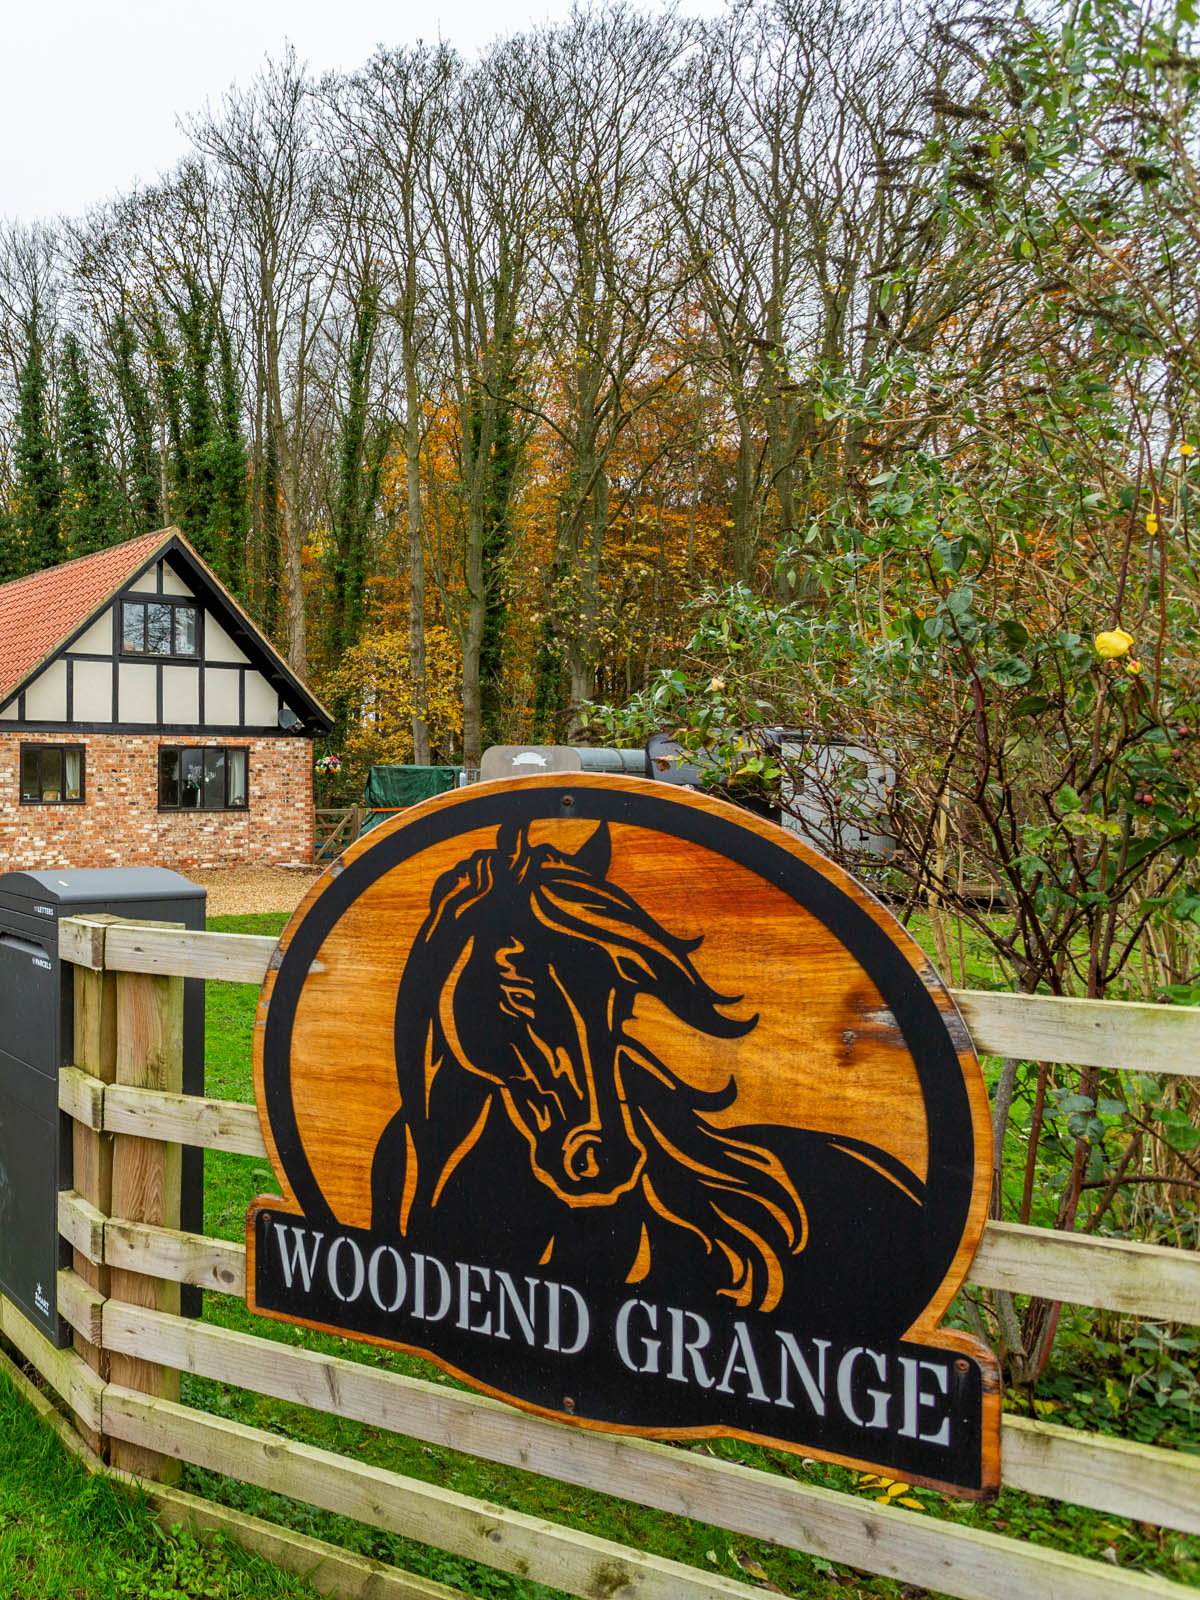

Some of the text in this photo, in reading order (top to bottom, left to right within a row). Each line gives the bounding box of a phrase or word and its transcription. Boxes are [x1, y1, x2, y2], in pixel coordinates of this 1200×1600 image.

[37, 905, 54, 916] LETTERS
[273, 1223, 950, 1447] WOODEND GRANGE
